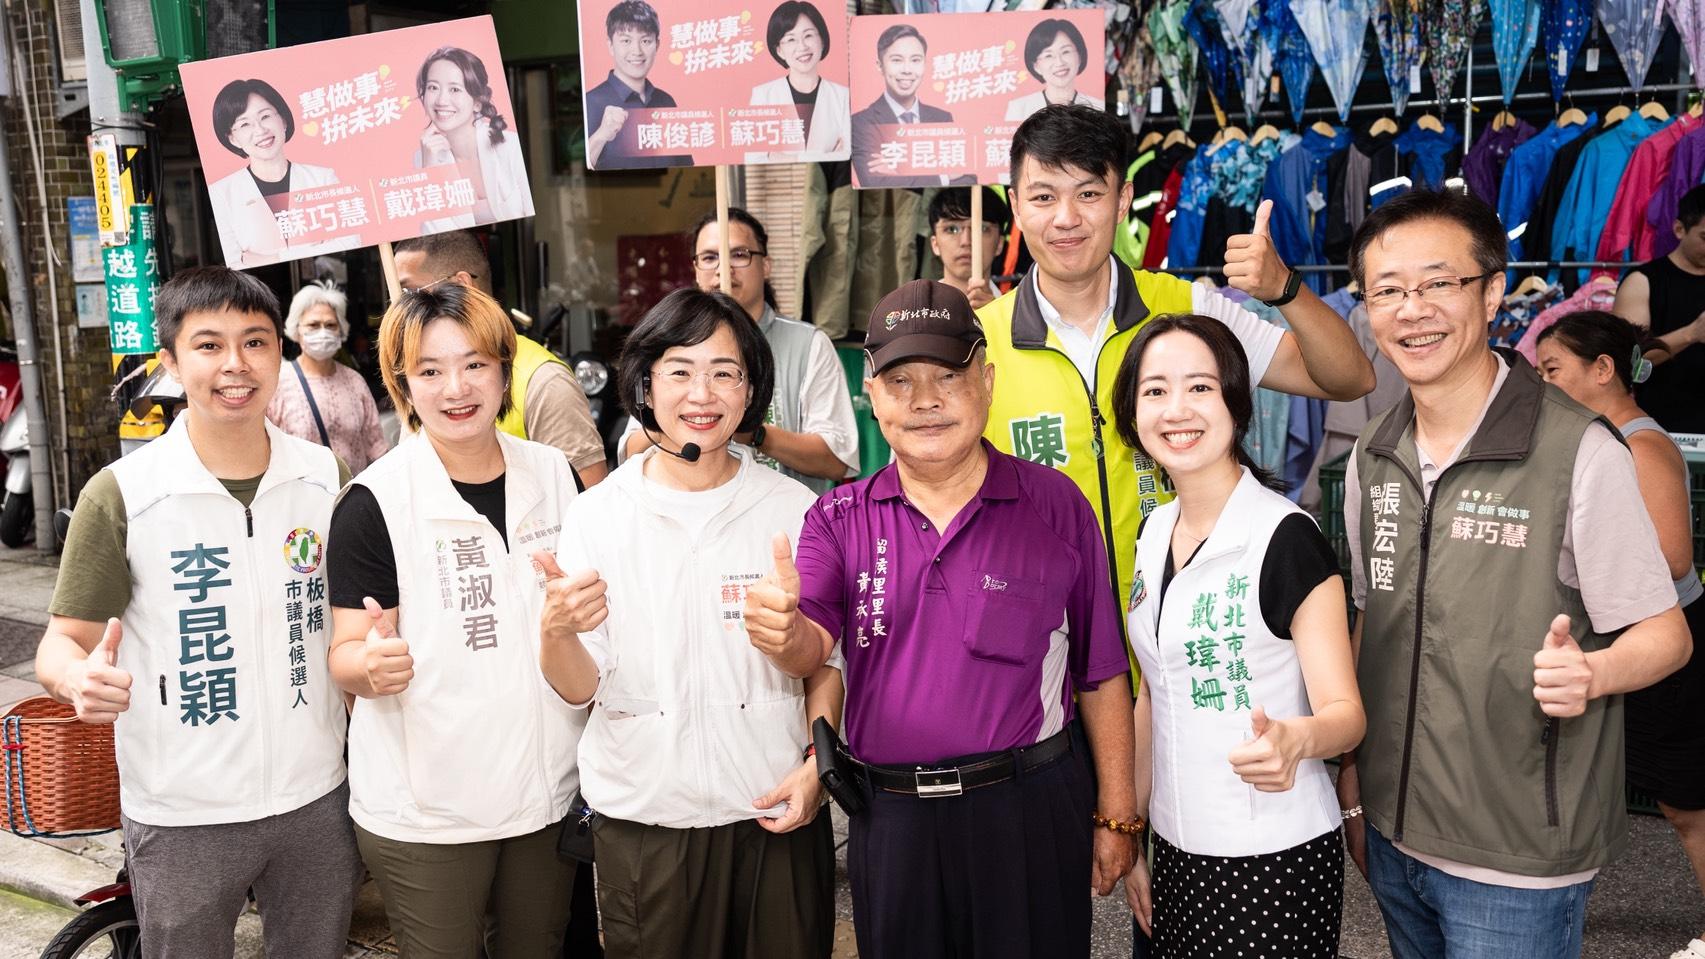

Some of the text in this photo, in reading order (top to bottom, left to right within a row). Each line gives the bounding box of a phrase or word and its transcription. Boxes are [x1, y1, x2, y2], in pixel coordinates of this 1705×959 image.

[671, 15, 741, 48] 慧做事
[684, 40, 754, 75] 拚未來
[932, 45, 1005, 80] 慧做事
[299, 71, 381, 119] 慧做事
[945, 69, 1018, 104] 拚未來
[321, 97, 402, 145] 拚未來
[637, 121, 716, 150] 陳俊諺
[730, 118, 806, 147] 蘇巧慧
[880, 140, 967, 169] 李昆穎
[275, 197, 370, 240] 蘇巧慧
[107, 214, 144, 349] 越道路
[900, 307, 951, 321] 新北市政府
[1010, 413, 1069, 468] 陳
[1450, 516, 1529, 549] 蘇巧慧
[1497, 506, 1530, 520] 會做事
[1370, 483, 1400, 592] 張宏陸
[437, 555, 453, 609] 新北市議員
[452, 536, 498, 652] 黃淑君
[721, 583, 752, 604] 蘇
[306, 576, 324, 634] 板橋
[171, 543, 240, 727] 李昆穎
[285, 578, 308, 709] 市議員候選人
[1223, 572, 1253, 711] 新北市議員
